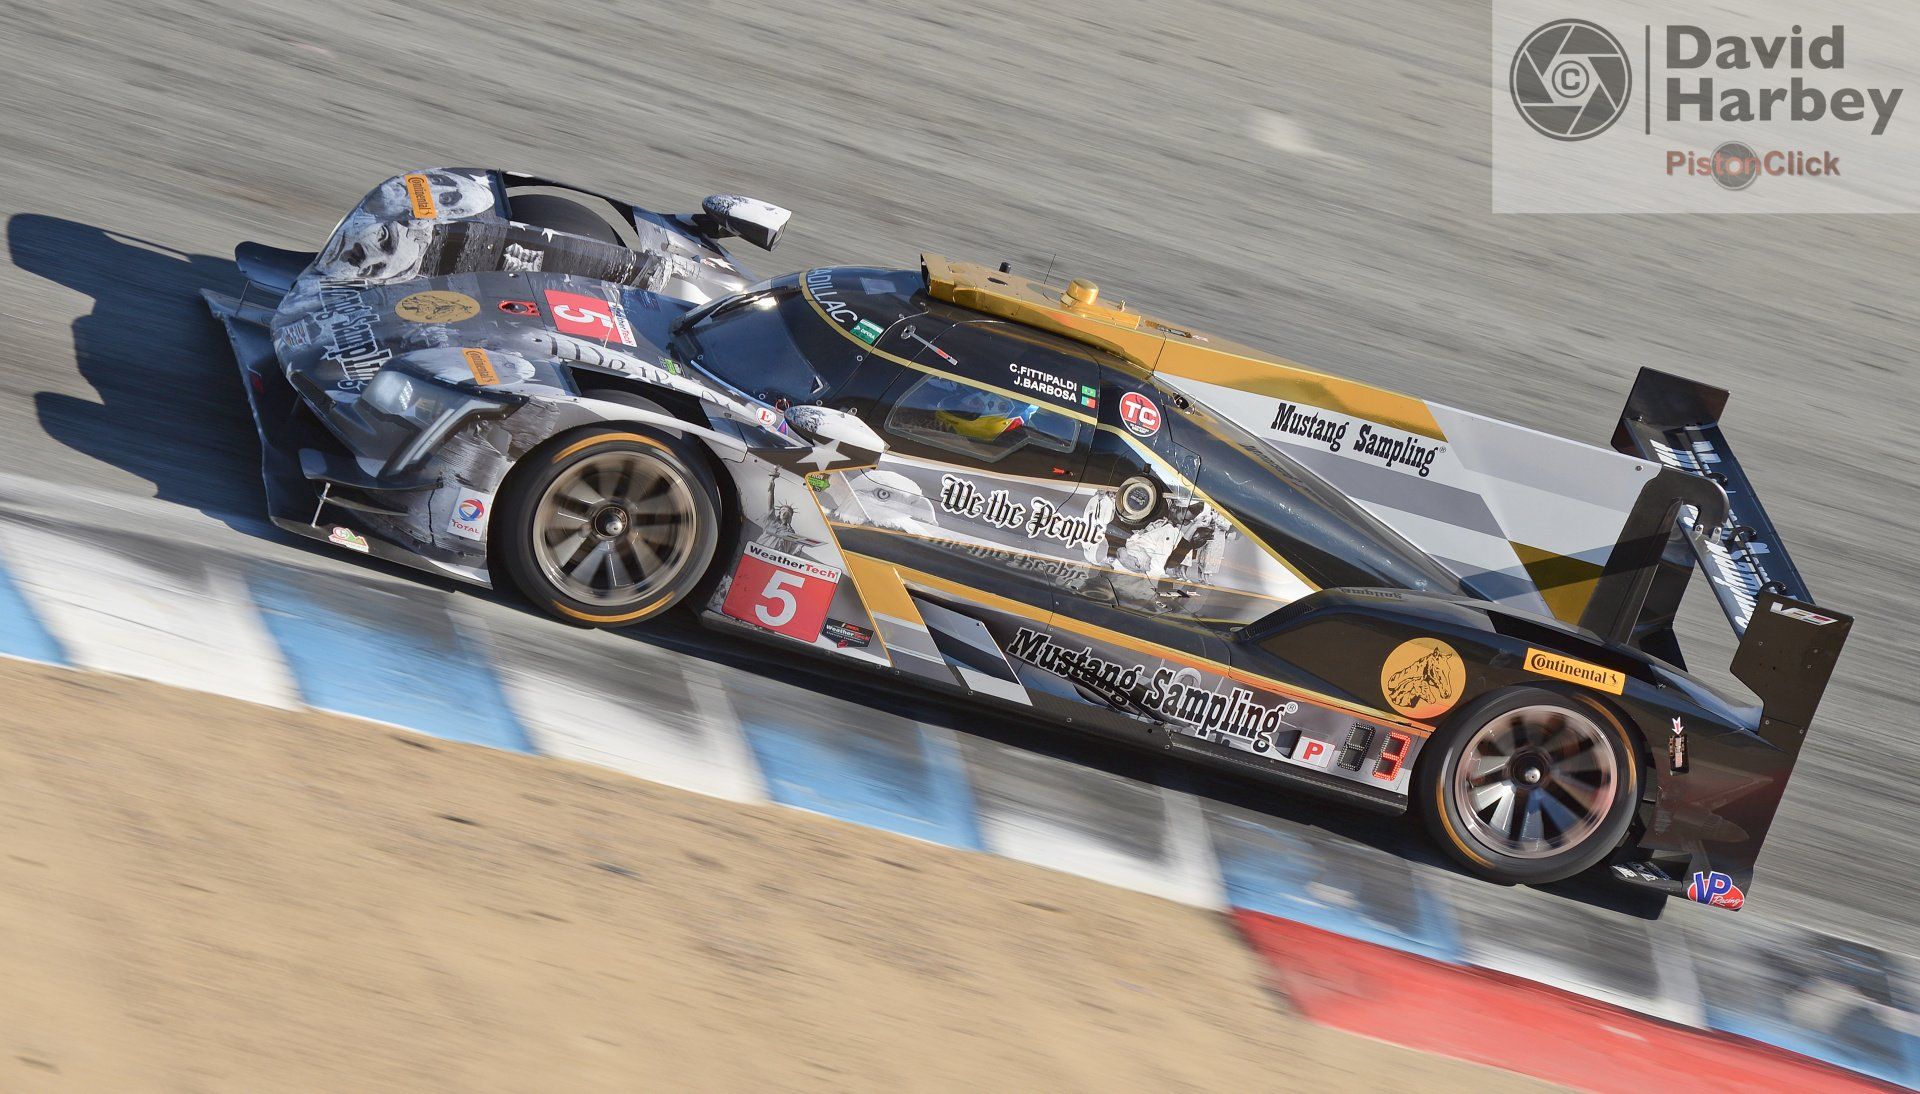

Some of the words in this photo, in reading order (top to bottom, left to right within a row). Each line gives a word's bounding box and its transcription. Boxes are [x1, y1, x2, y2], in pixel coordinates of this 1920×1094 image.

[807, 269, 858, 323] ADILLAC
[553, 304, 614, 329] 5
[1009, 363, 1078, 392] C.FITTIPALDI
[1013, 376, 1077, 403] J.BARBOSA
[1125, 399, 1158, 426] TC
[1271, 402, 1350, 452] Mustang
[1353, 424, 1438, 478] Sampling
[451, 518, 480, 535] TOTAL
[941, 474, 985, 518] We
[983, 490, 1027, 528] the
[1026, 497, 1107, 549] People
[749, 545, 838, 579] WeatherTech
[754, 569, 806, 627] 5
[1530, 653, 1608, 685] Continental
[1006, 627, 1142, 707] Mustang
[1141, 667, 1286, 754] Sampling
[1303, 741, 1324, 760] P
[1693, 870, 1733, 905] VP
[1711, 895, 1742, 907] Racing
